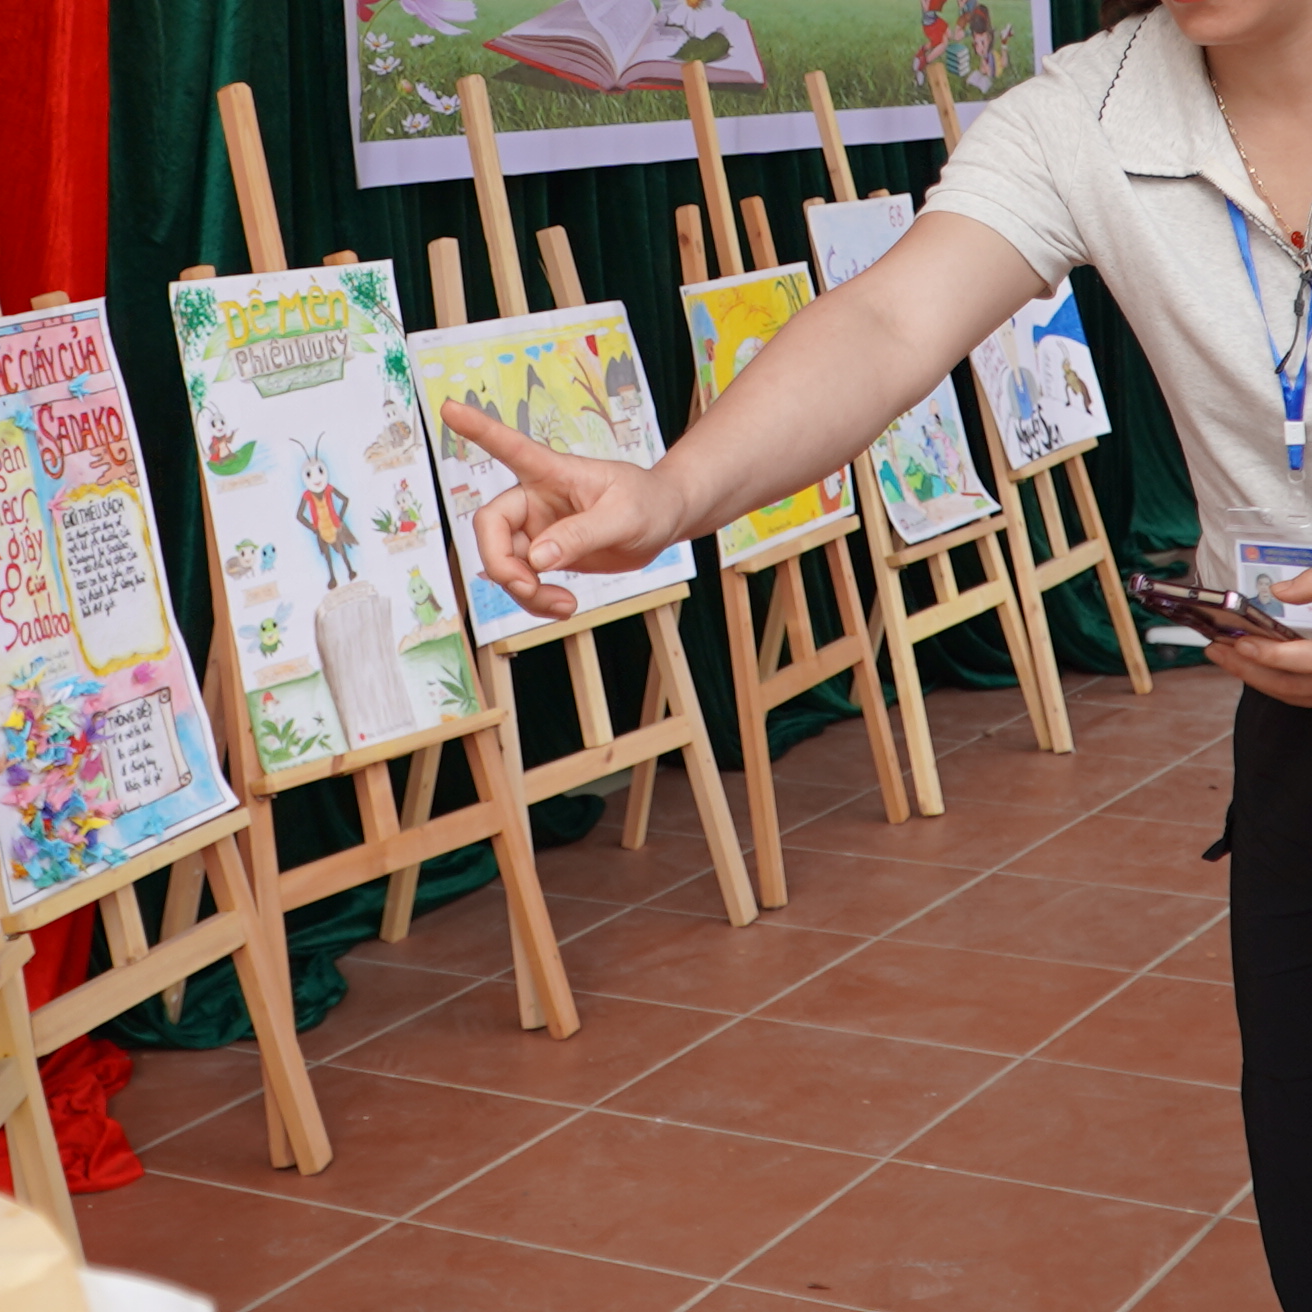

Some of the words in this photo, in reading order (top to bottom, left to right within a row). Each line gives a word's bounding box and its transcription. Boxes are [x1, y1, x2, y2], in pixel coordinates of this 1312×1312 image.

[218, 279, 271, 349] Dế
[278, 275, 349, 336] Mèn
[58, 326, 104, 381] CỦA
[235, 337, 294, 377] Phiêu
[38, 403, 127, 480] SADAKO
